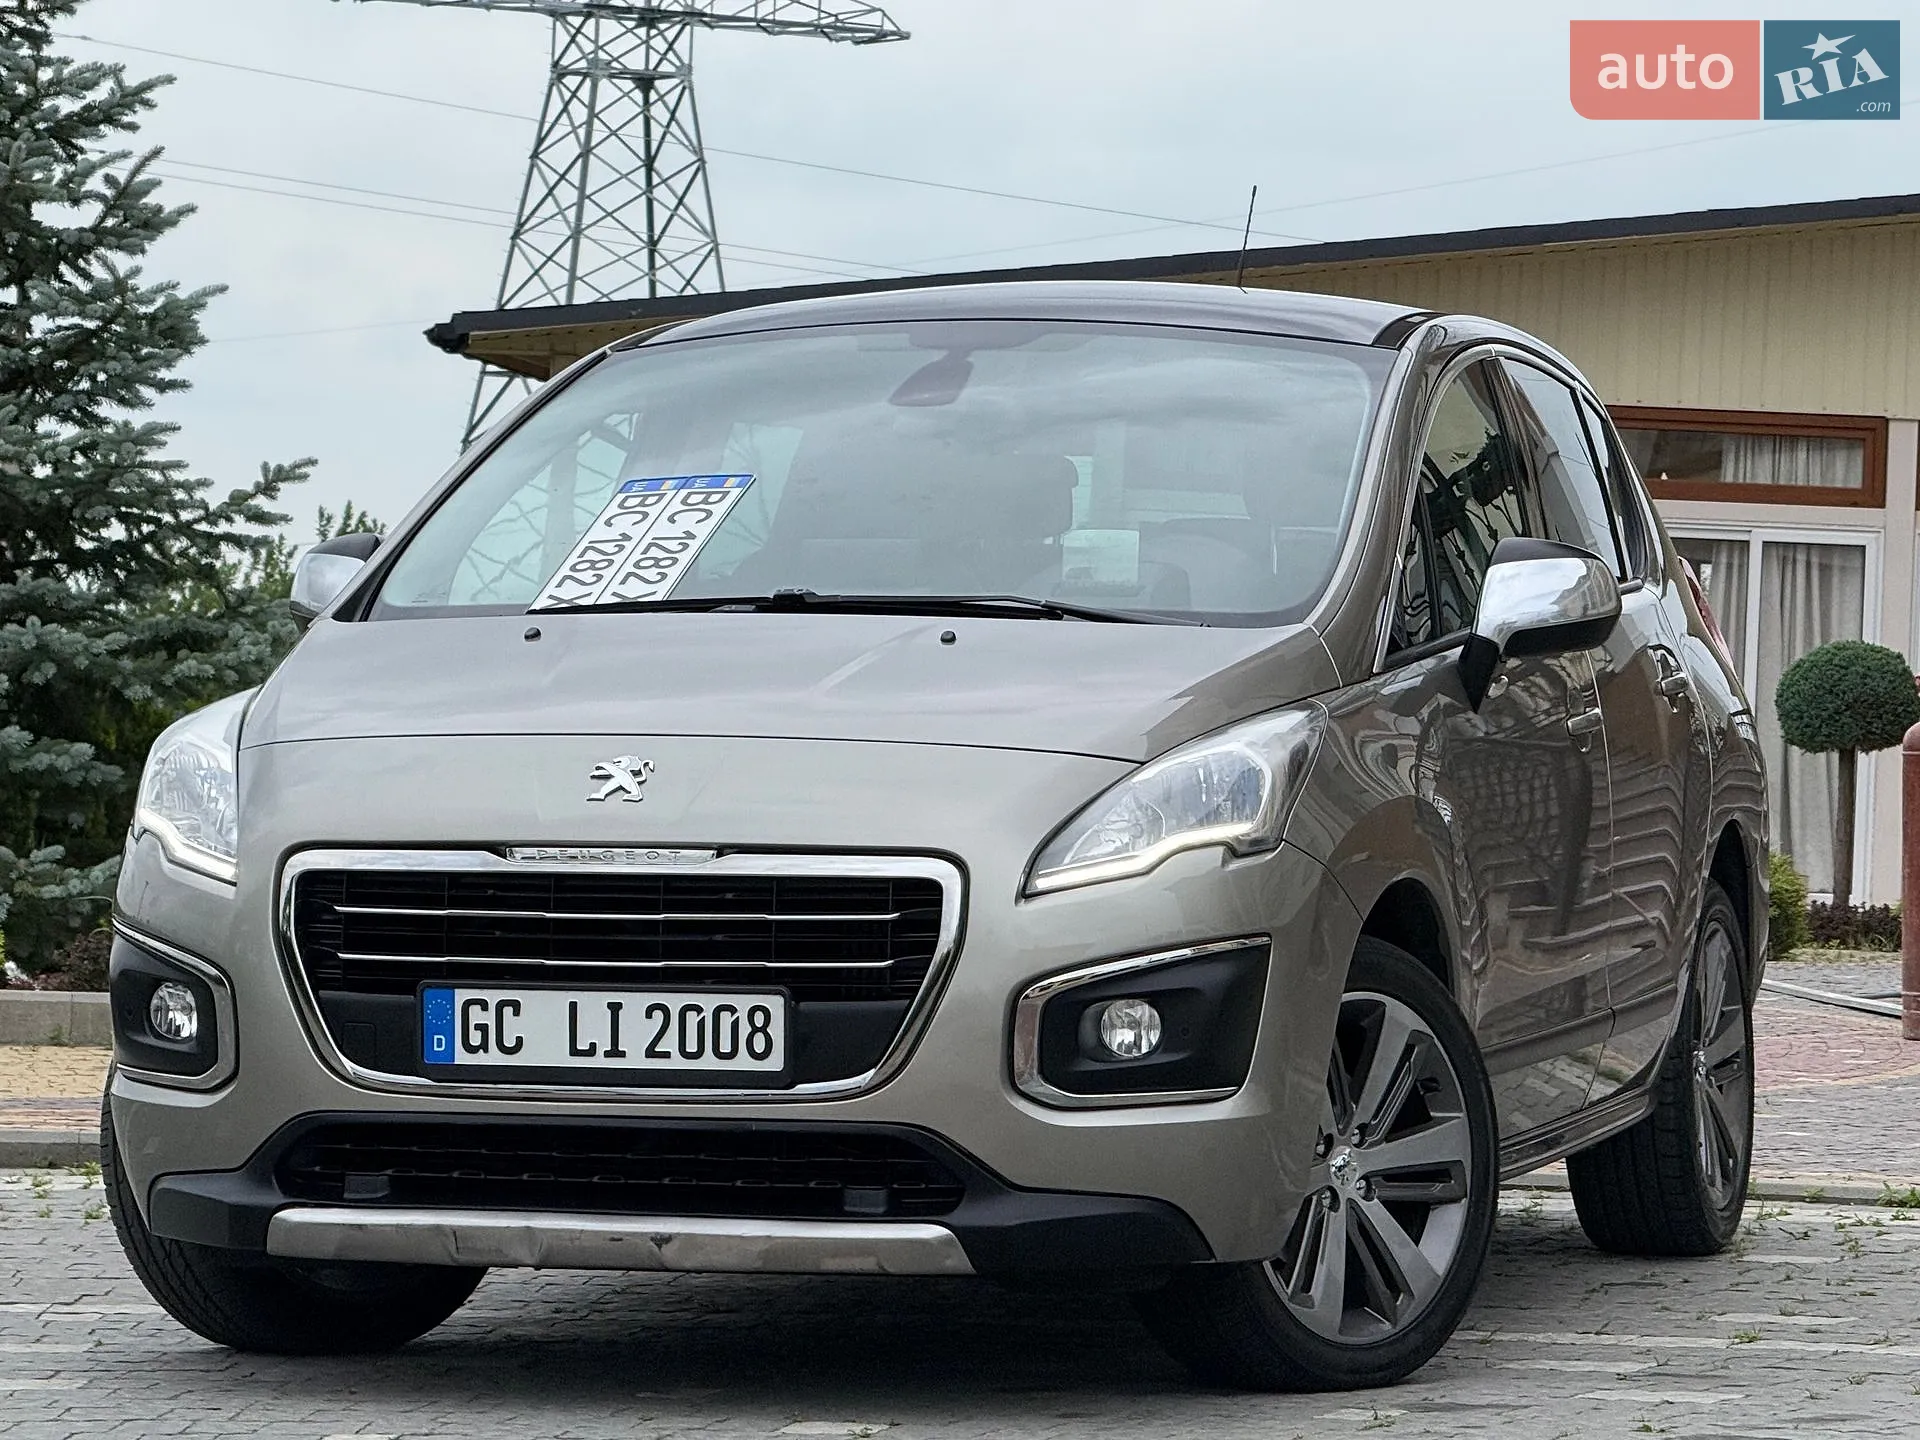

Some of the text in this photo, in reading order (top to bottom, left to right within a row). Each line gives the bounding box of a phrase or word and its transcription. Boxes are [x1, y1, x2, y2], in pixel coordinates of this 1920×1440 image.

[630, 481, 649, 493] UA
[692, 478, 711, 489] UA
[603, 492, 668, 528] BC
[667, 490, 731, 525] BC
[555, 531, 633, 589] 1282
[618, 529, 698, 586] 1282
[535, 849, 682, 863] PEUGEOT
[433, 1034, 446, 1052] D
[460, 997, 774, 1061] GC LI 2008
